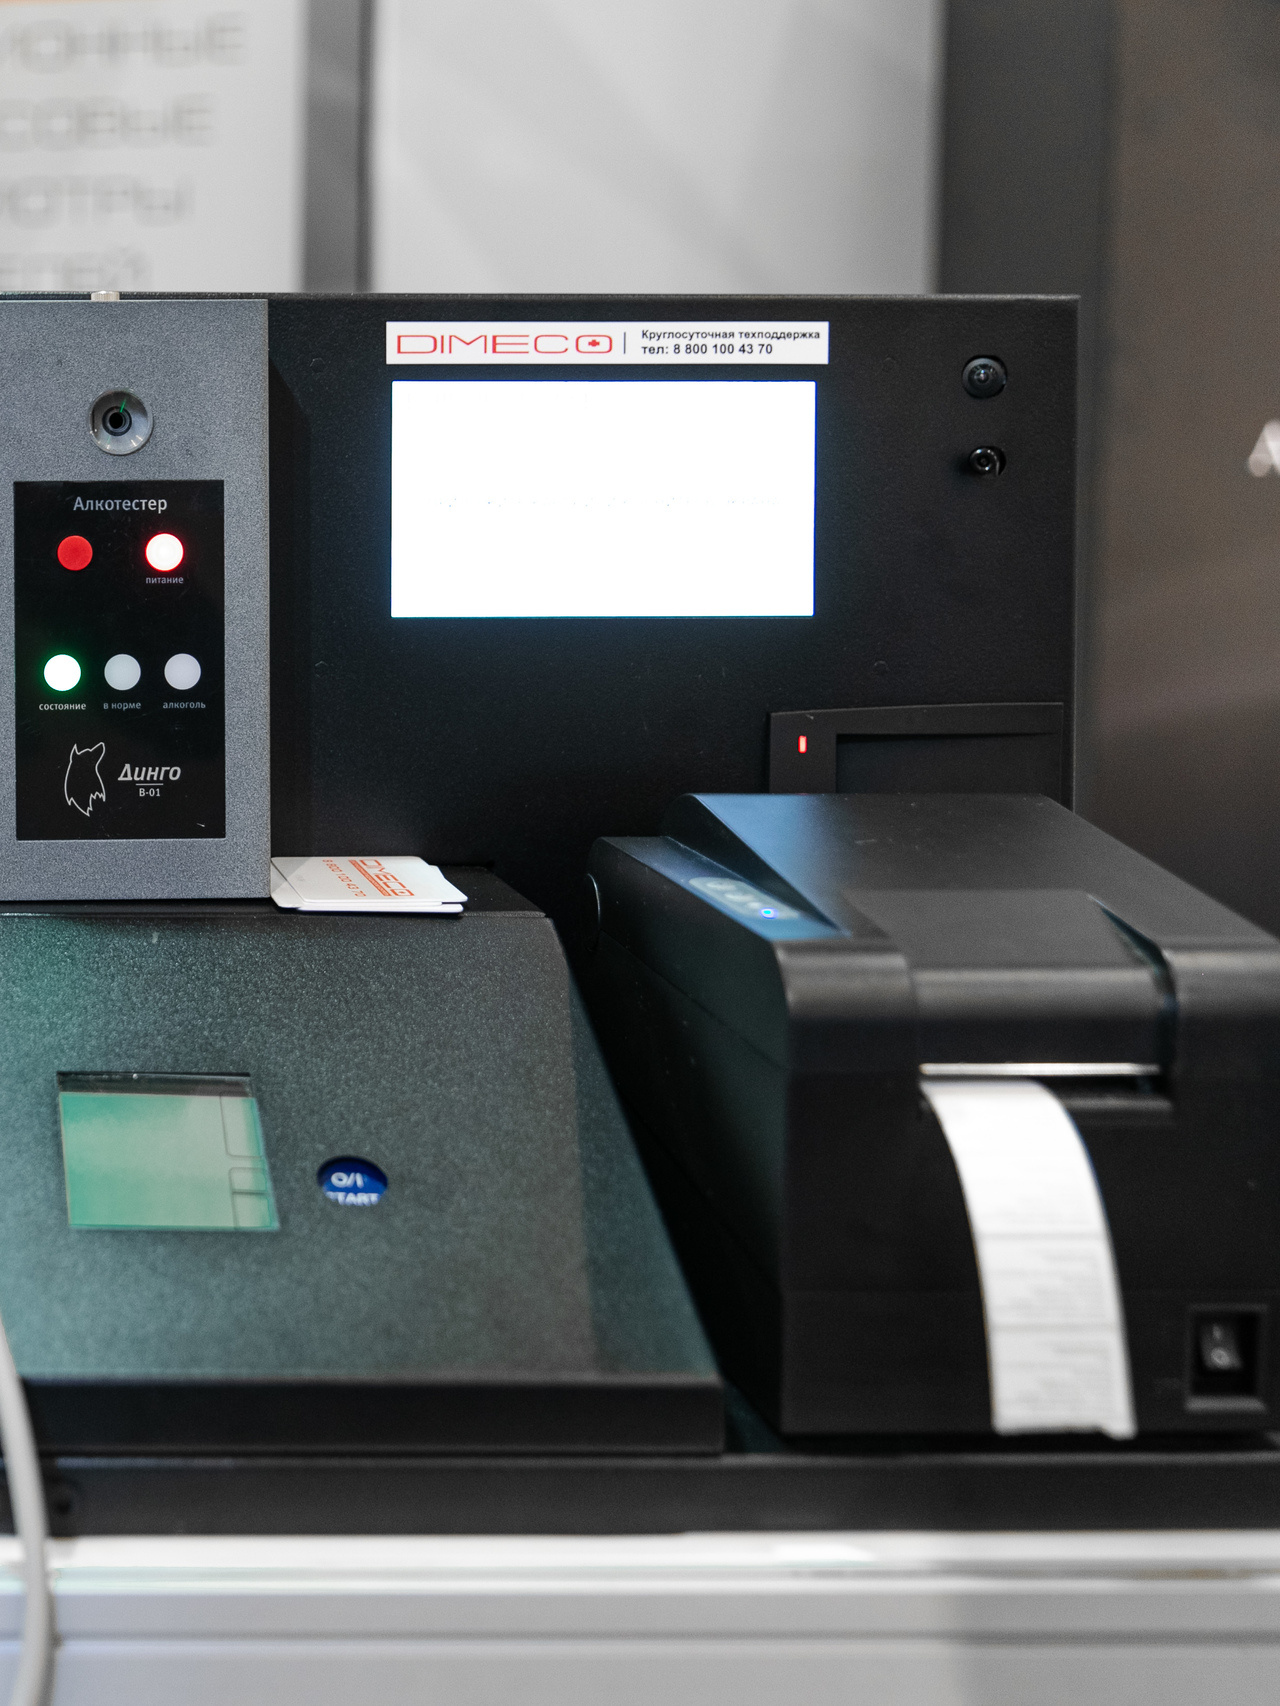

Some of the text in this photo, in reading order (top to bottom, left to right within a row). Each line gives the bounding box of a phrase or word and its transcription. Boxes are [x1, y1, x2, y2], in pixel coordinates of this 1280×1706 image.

[641, 329, 821, 341] Круглосуточная техподдержка
[397, 334, 613, 354] DIMECO
[641, 344, 774, 355] тел: 8 800 100 43 70
[73, 496, 168, 514] Алкотестер
[145, 576, 184, 585] питание
[38, 702, 87, 711] состояние
[103, 702, 142, 711] в норме
[162, 700, 207, 710] алкоголь
[117, 763, 182, 781] Динго
